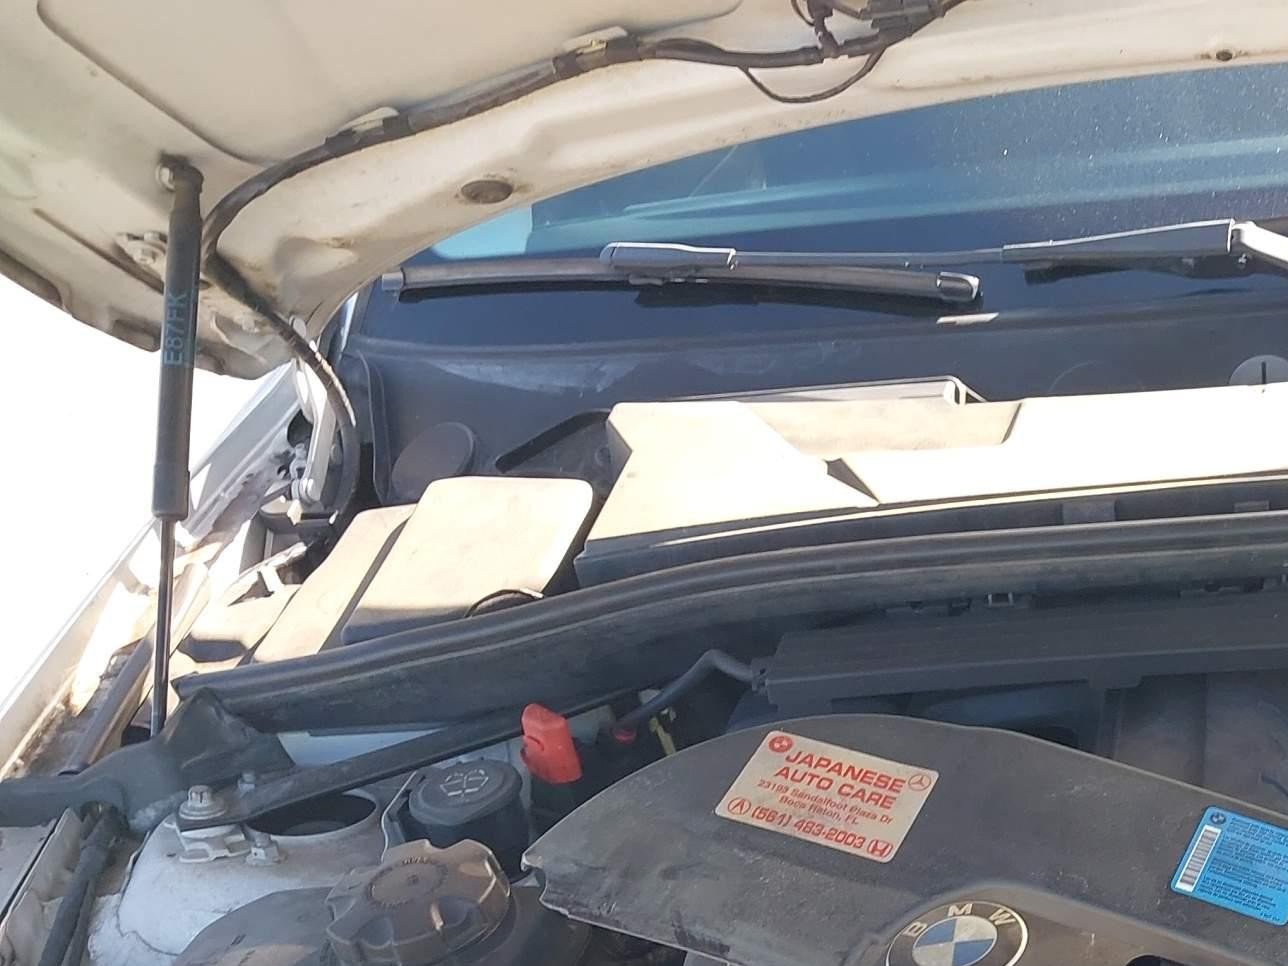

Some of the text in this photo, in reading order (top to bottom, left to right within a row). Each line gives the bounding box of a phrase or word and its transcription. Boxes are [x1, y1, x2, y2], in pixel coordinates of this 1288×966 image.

[774, 766, 897, 810] AUTO CARE
[785, 751, 906, 794] JAPANESE
[779, 795, 806, 809] Boca
[849, 805, 877, 820] Plaza
[880, 814, 893, 824] Dr
[752, 806, 866, 849] (561) 483-2003
